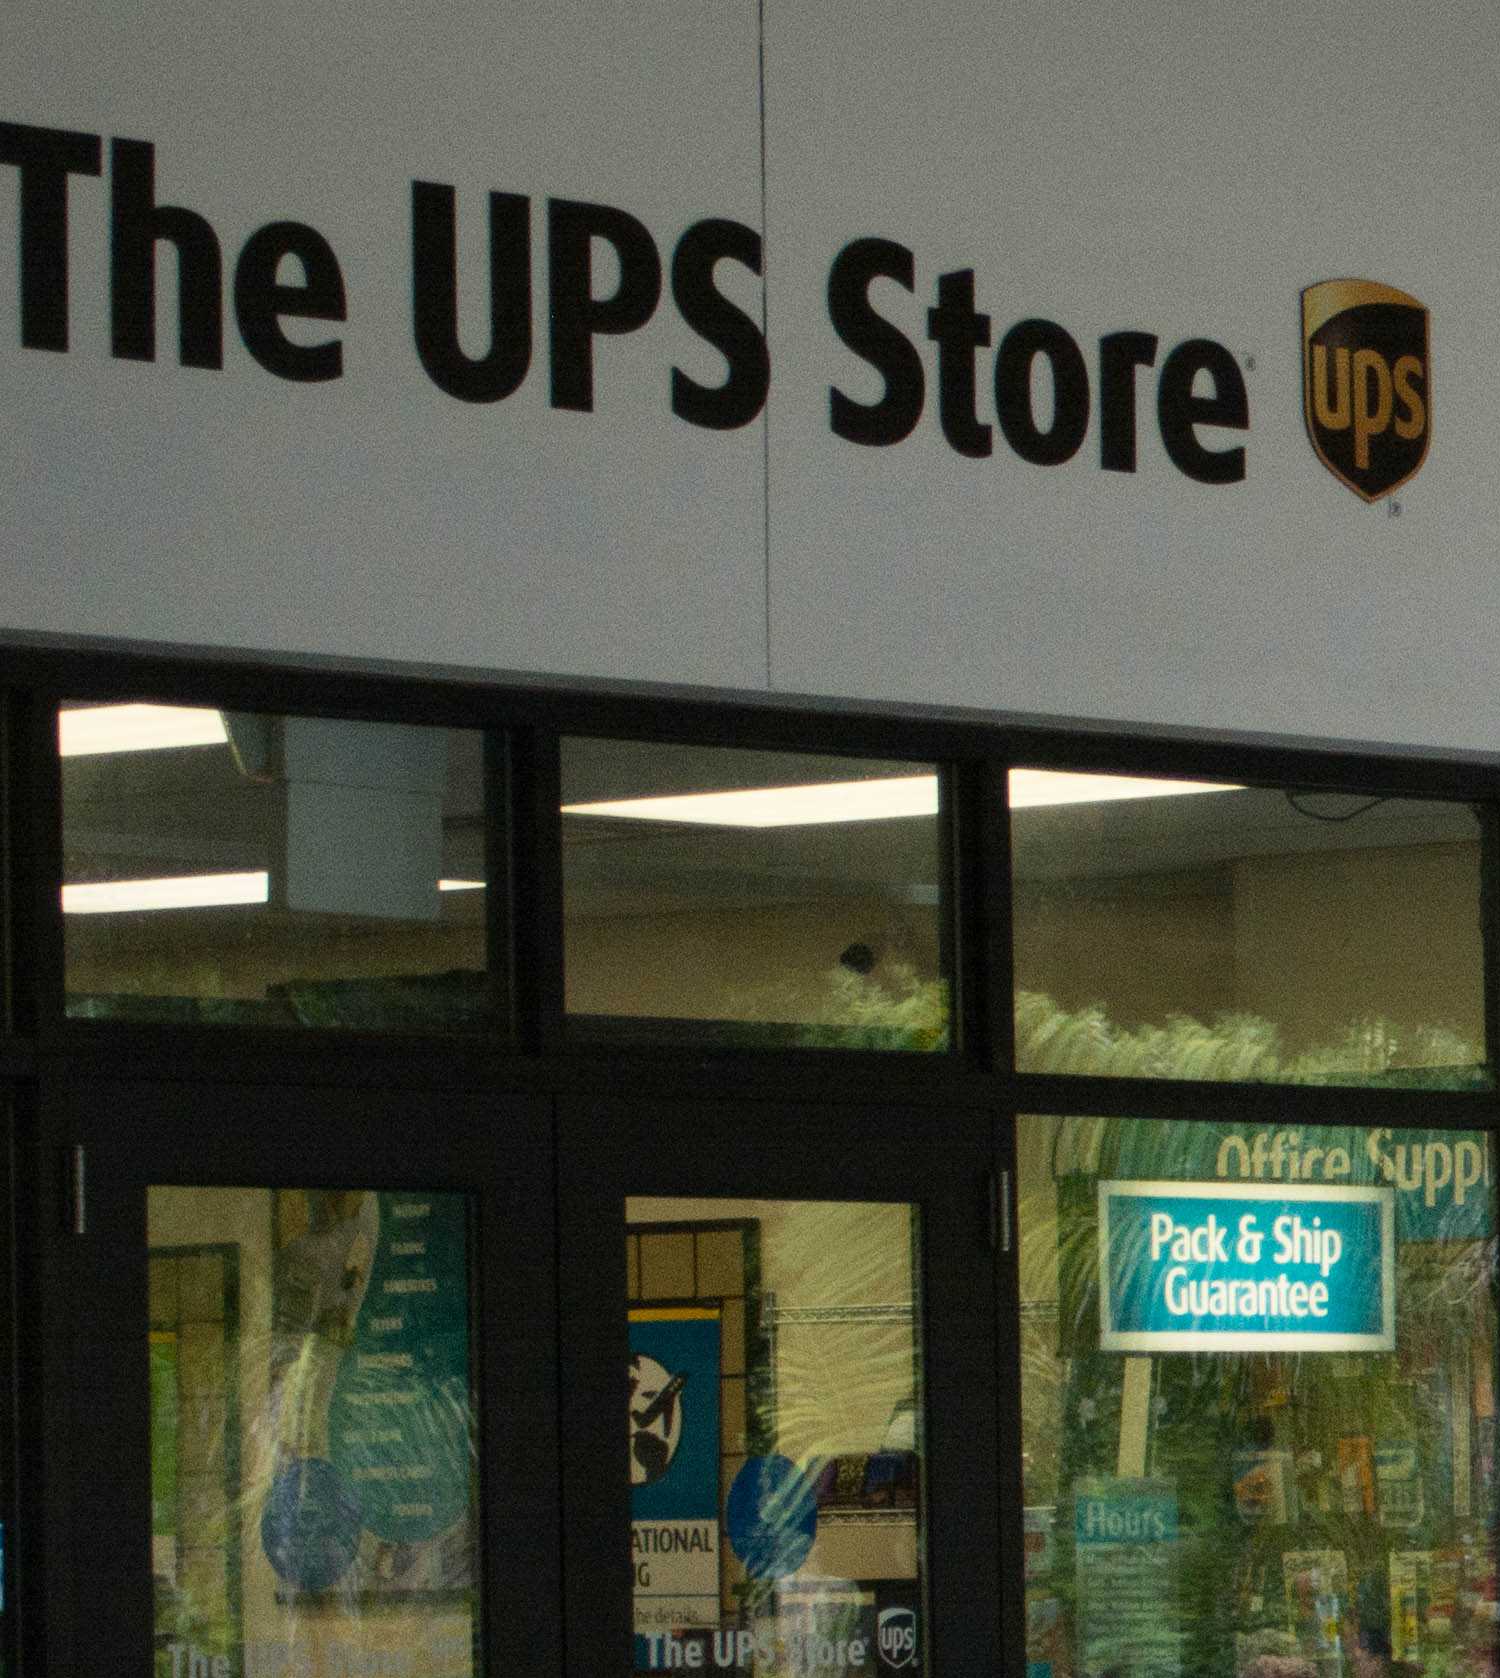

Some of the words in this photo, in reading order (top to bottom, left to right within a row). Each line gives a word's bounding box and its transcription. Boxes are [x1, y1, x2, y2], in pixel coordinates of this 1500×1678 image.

[0, 120, 347, 383] The
[411, 180, 772, 431] UPS
[826, 237, 1250, 485] Store
[1311, 344, 1428, 469] ups
[1149, 1213, 1229, 1262] Pack
[1236, 1213, 1265, 1263] &
[1272, 1216, 1343, 1277] Ship
[1164, 1268, 1329, 1317] Guarantee
[1084, 1501, 1166, 1538] Hours
[646, 1631, 703, 1669] The
[713, 1631, 776, 1670] UPS
[880, 1624, 914, 1659] ups
